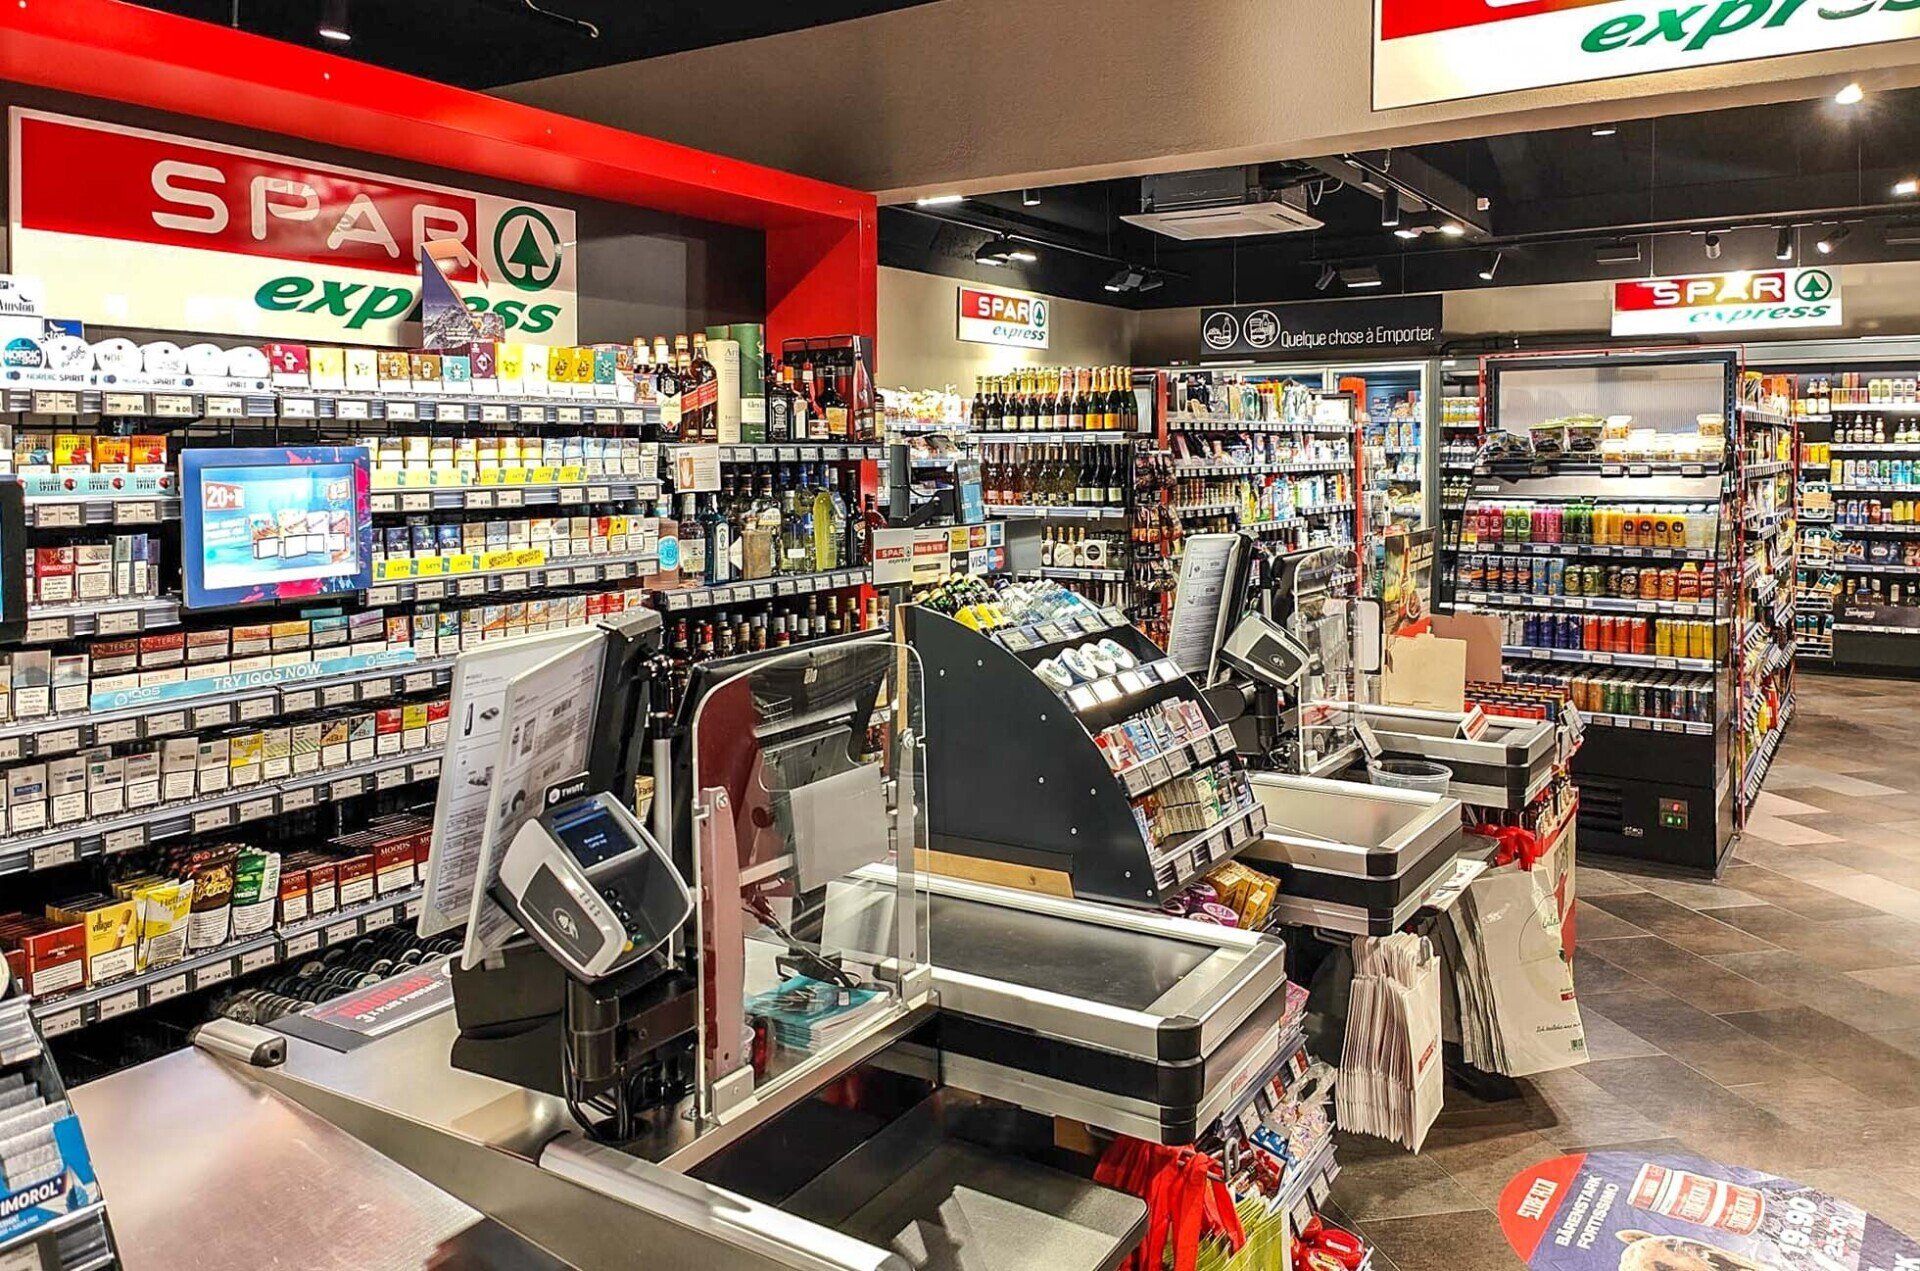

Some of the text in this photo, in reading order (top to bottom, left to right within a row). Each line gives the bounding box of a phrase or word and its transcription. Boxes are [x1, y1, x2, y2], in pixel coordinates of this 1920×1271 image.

[151, 159, 470, 268] SPAR
[1651, 276, 1783, 306] SPAR
[977, 296, 1029, 321] SPAR
[1688, 303, 1831, 324] express
[992, 325, 1046, 342] express
[1281, 325, 1436, 348] Quelque chose à Emporter.
[60, 375, 85, 383] SPIRIT
[970, 555, 986, 568] VISA
[109, 641, 136, 651] TEREA
[157, 635, 183, 646] TEREA
[213, 662, 323, 690] TRY IQOS NOW.
[129, 687, 161, 698] IQOS
[380, 841, 411, 856] MOODS
[283, 875, 306, 885] MOODS
[312, 867, 335, 878] MOODS
[60, 1018, 79, 1030] 12.00
[1555, 1174, 1602, 1247] BÄRENSTARK
[1576, 1183, 1620, 1250] FORTISSIMO
[1778, 1196, 1818, 1255] 19.90
